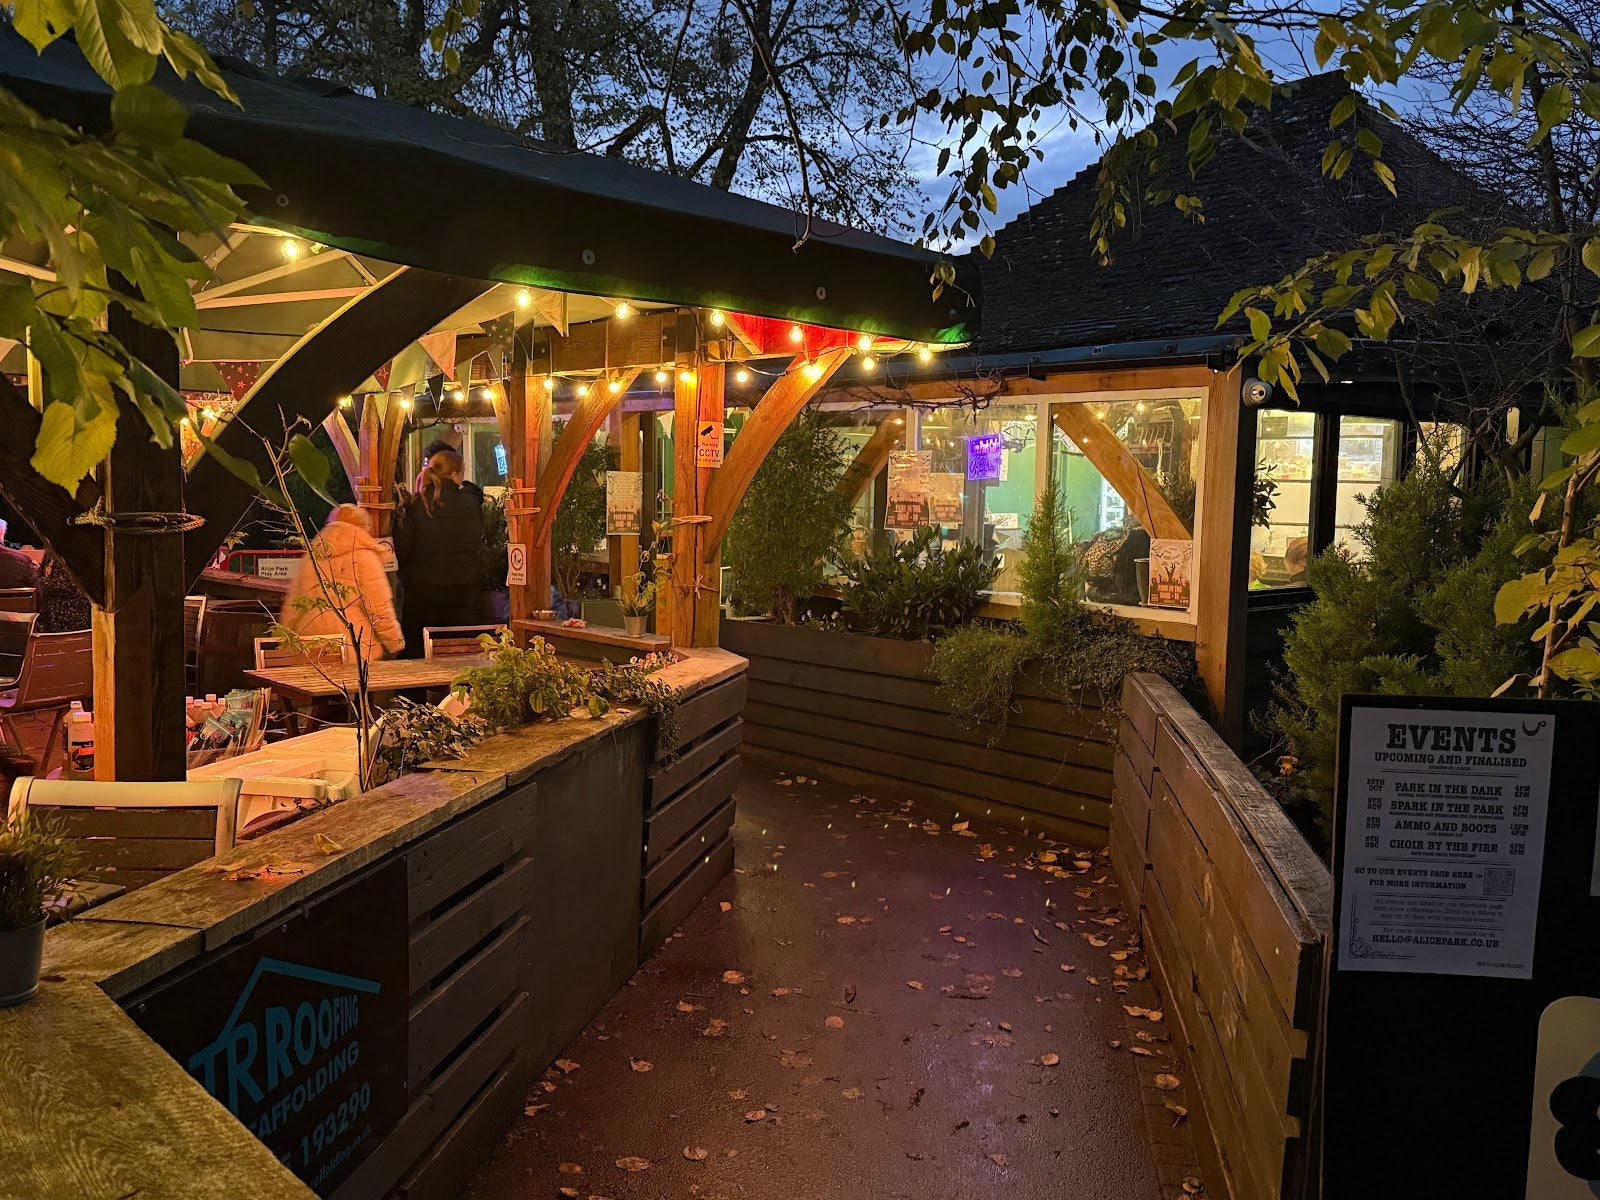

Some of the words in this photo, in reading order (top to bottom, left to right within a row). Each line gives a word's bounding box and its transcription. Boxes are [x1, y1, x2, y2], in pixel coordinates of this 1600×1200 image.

[699, 449, 719, 457] CCTV
[1386, 724, 1516, 754] EVENTS
[1375, 752, 1434, 763] UPCOMING
[1437, 754, 1461, 765] AND
[1465, 756, 1526, 767] FINALISED
[1395, 783, 1425, 792] PARK
[1429, 784, 1441, 793] IN
[1445, 785, 1467, 794] THE
[1471, 786, 1502, 796] DARK
[1391, 800, 1427, 811] SPARK
[1431, 803, 1444, 812] IN
[1447, 803, 1470, 813] THE
[1474, 805, 1504, 814] PARK
[1395, 820, 1430, 830] AMMO
[1434, 822, 1457, 832] AND
[1461, 823, 1496, 833] BOOTS
[1390, 840, 1424, 849] CHOIR
[1428, 841, 1442, 850] BY
[1446, 842, 1468, 851] THE
[1472, 843, 1498, 853] FIRE
[1411, 881, 1467, 890] INFORMATION
[1372, 934, 1500, 948] HELLO@ALICEPARK.CO.UK
[265, 994, 360, 1092] ROOFING
[250, 1040, 360, 1140] AFFOLDING
[301, 1081, 372, 1167] 193290
